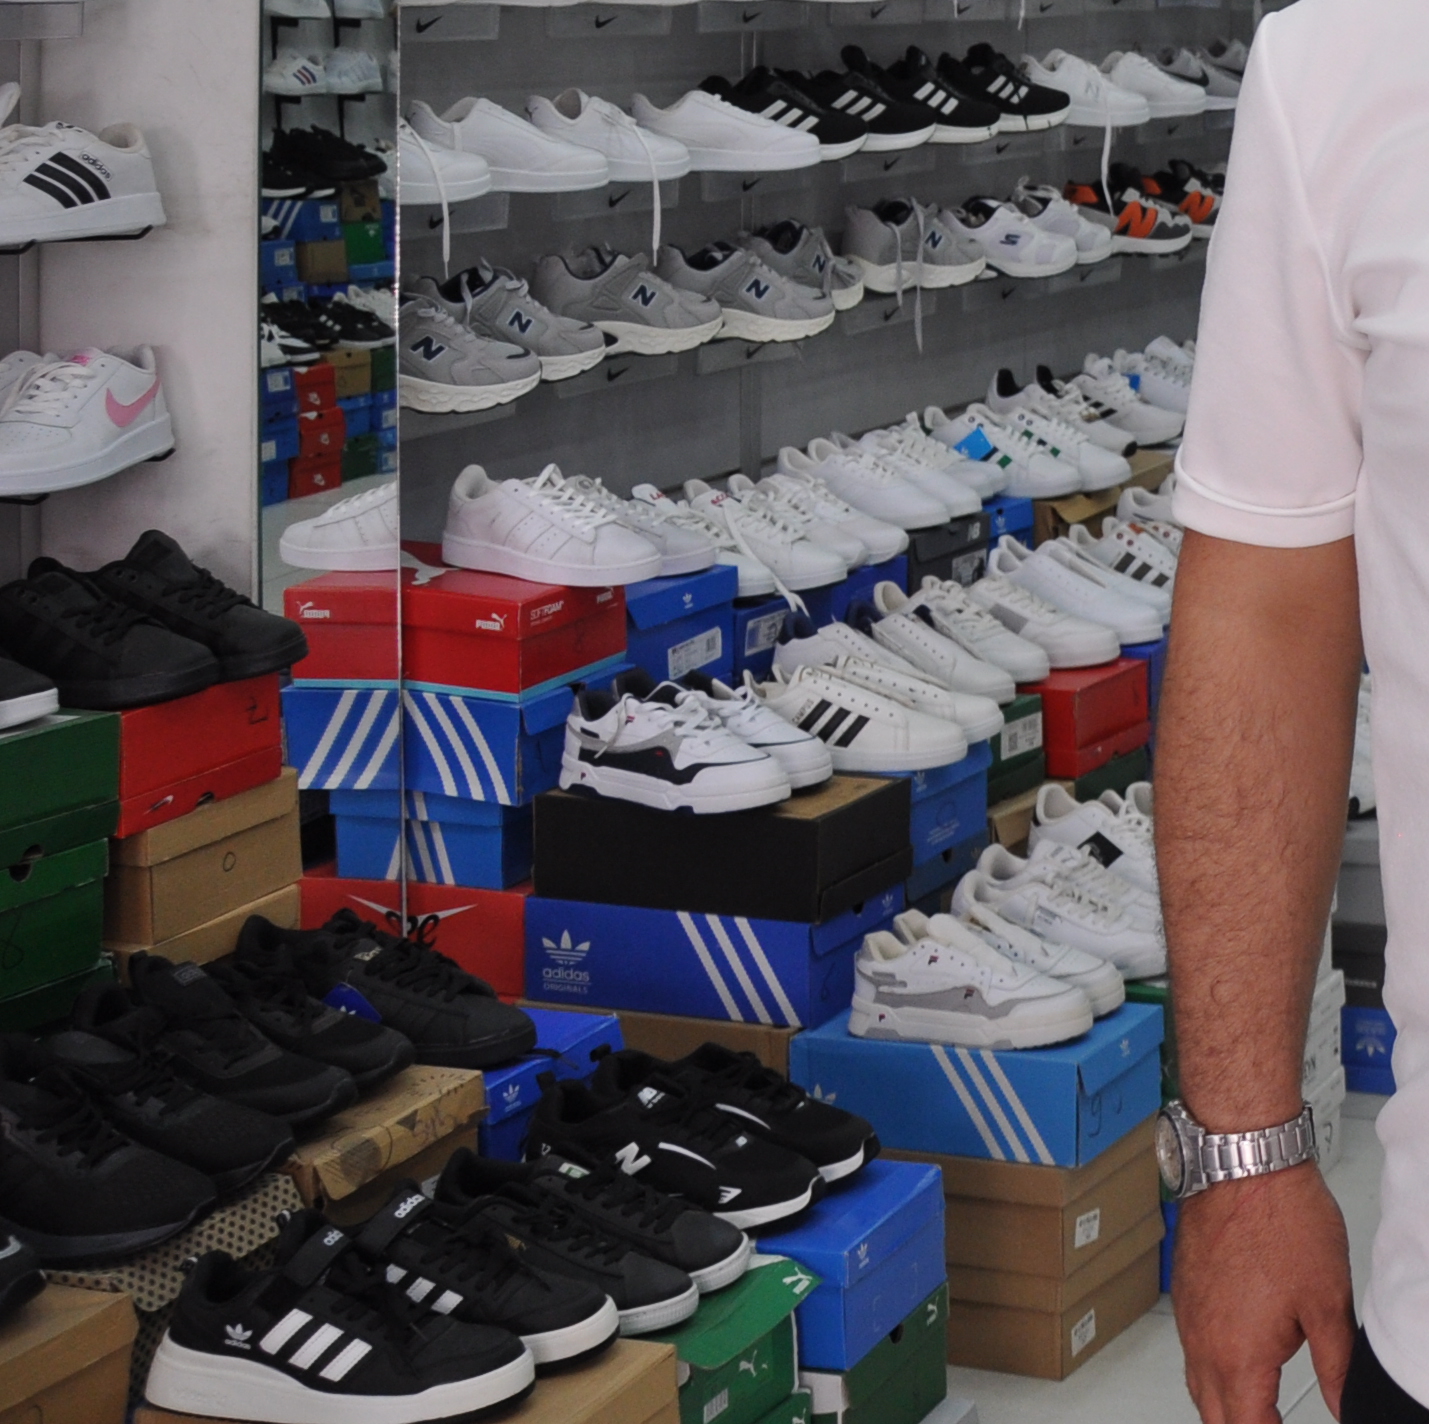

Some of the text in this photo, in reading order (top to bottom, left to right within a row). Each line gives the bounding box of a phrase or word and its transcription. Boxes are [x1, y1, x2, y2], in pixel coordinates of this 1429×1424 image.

[81, 153, 111, 180] adidas
[924, 229, 943, 249] N
[631, 284, 657, 307] N
[745, 278, 770, 300] N
[508, 310, 533, 334] N
[409, 335, 446, 362] N
[543, 966, 591, 983] adidas
[543, 982, 589, 995] ORIGINALS
[614, 1140, 653, 1176] N
